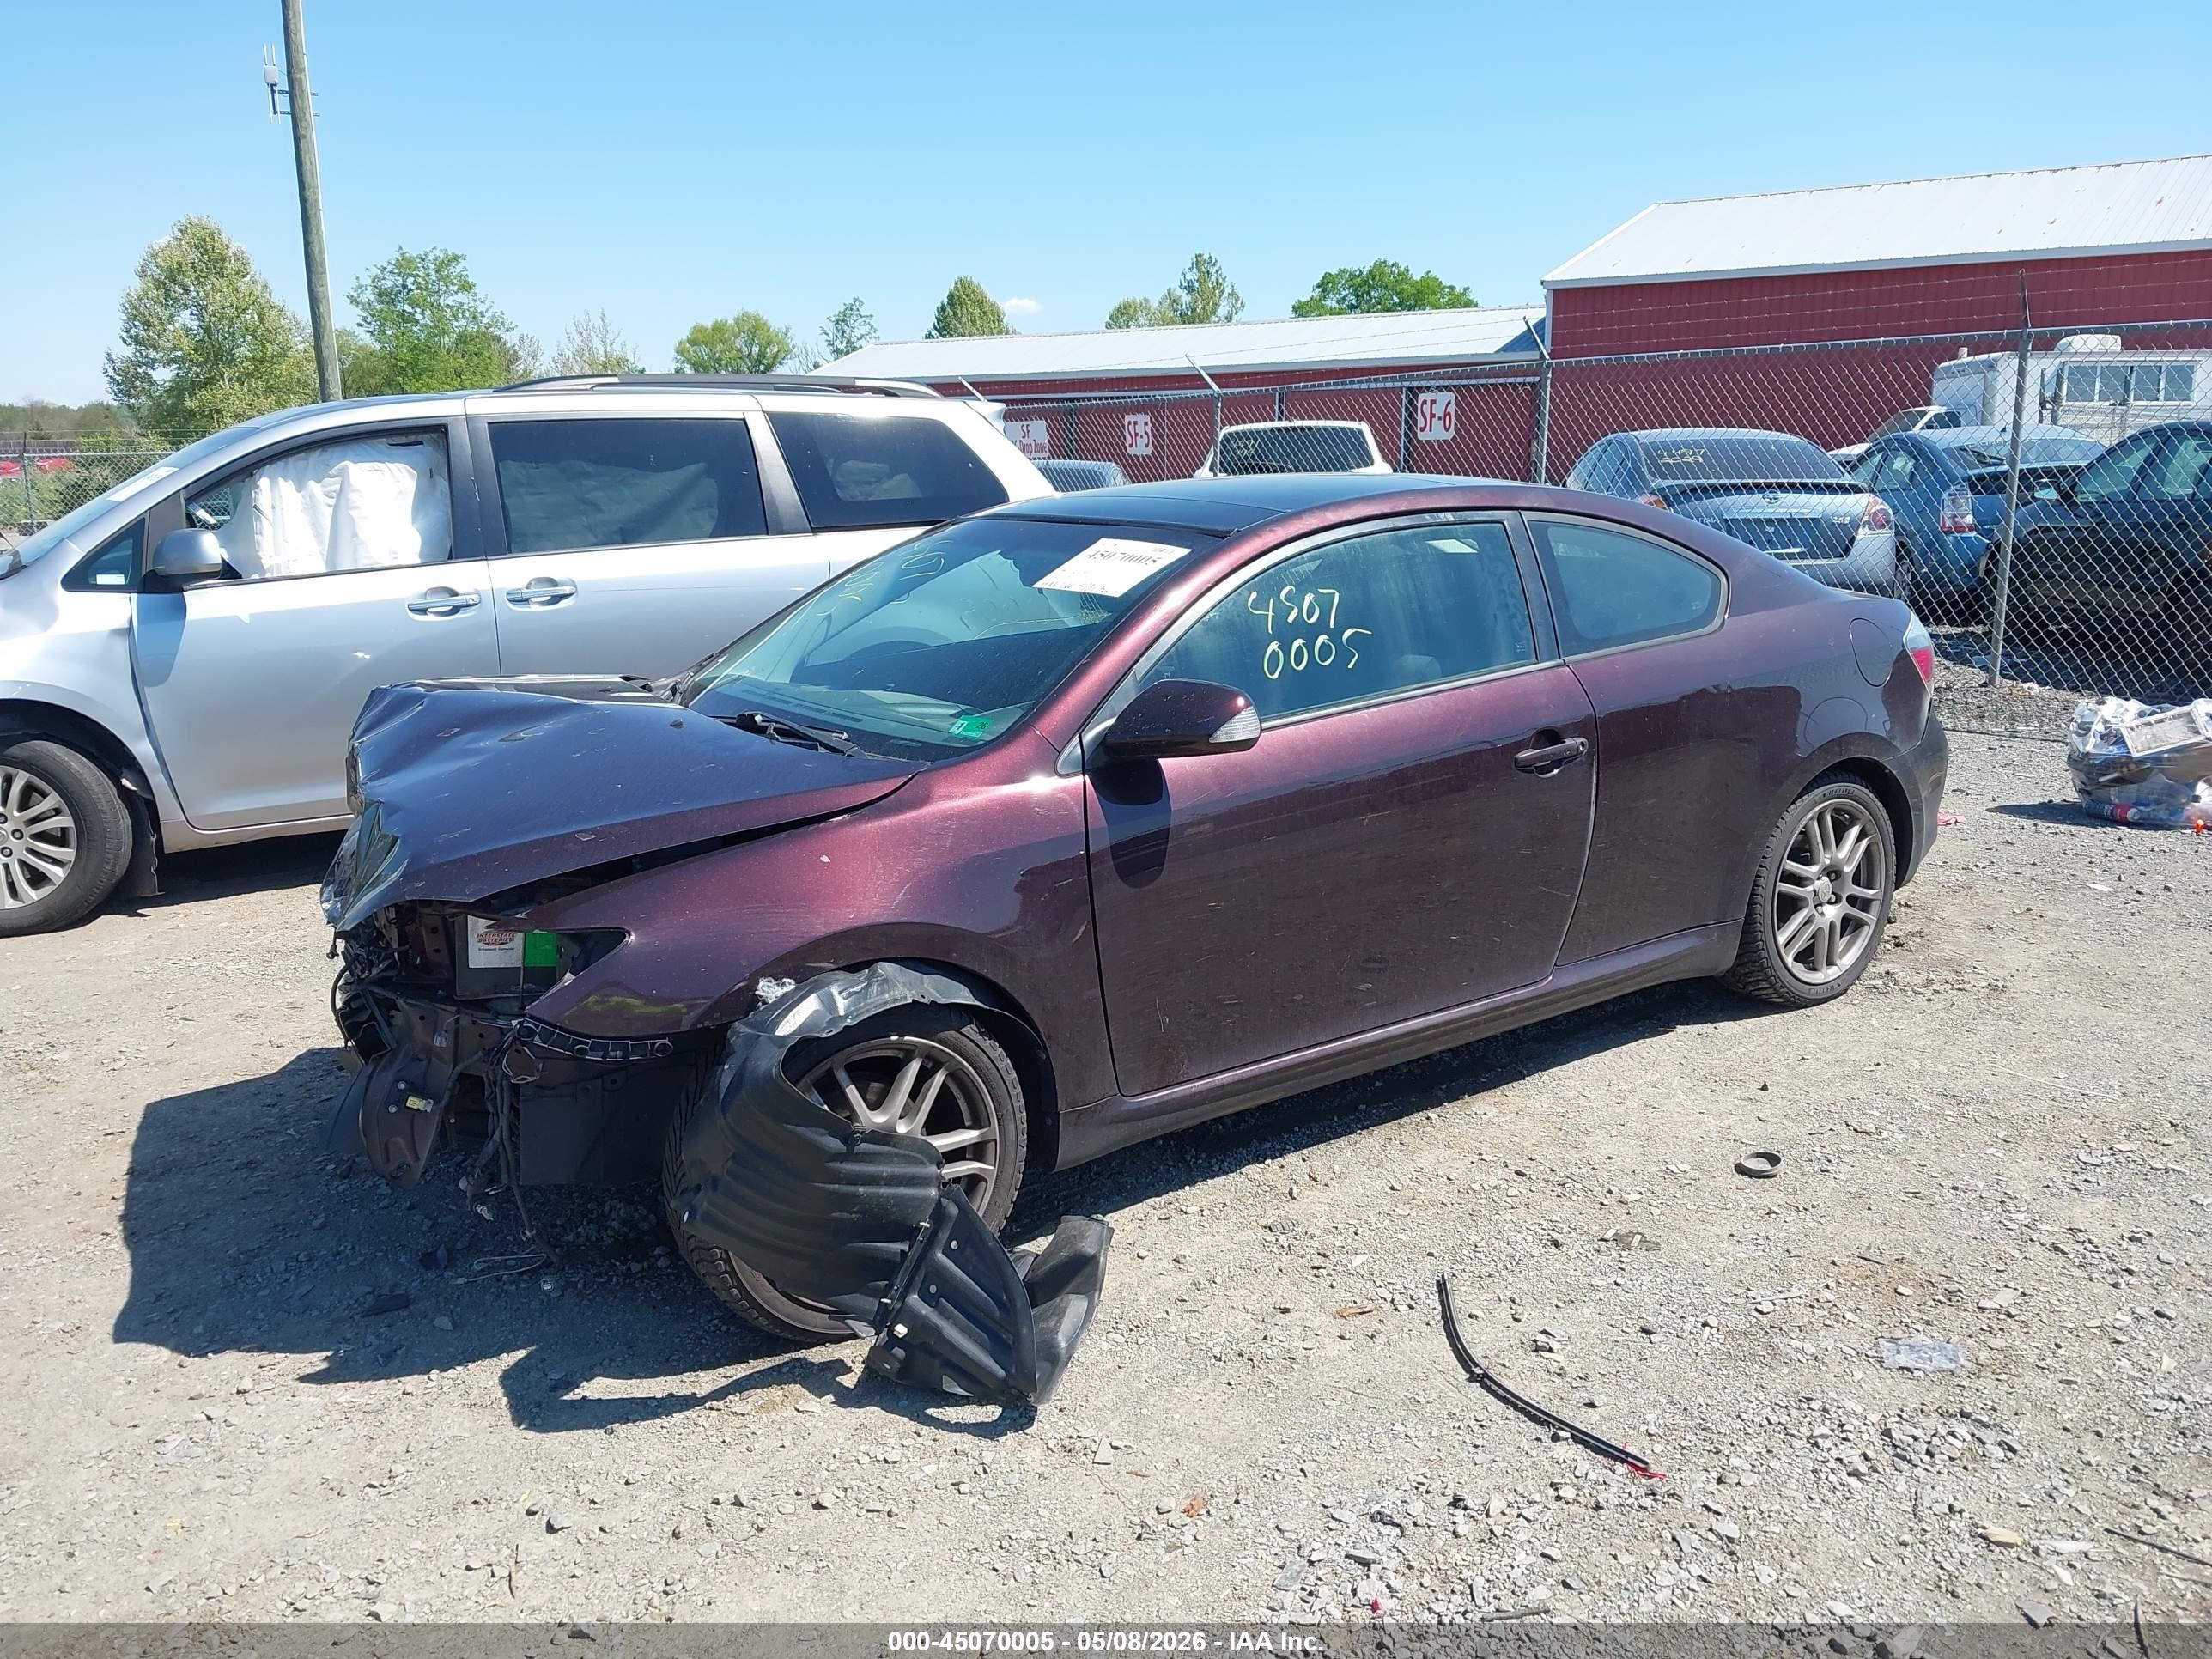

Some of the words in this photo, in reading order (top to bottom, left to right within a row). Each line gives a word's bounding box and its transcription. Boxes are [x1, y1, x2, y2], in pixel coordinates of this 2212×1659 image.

[1020, 424, 1031, 439] SF
[1419, 399, 1452, 433] SF-6
[1033, 439, 1048, 454] Zone
[1127, 420, 1150, 448] SF-5
[1247, 586, 1340, 634] 4507
[1263, 628, 1373, 679] 0005
